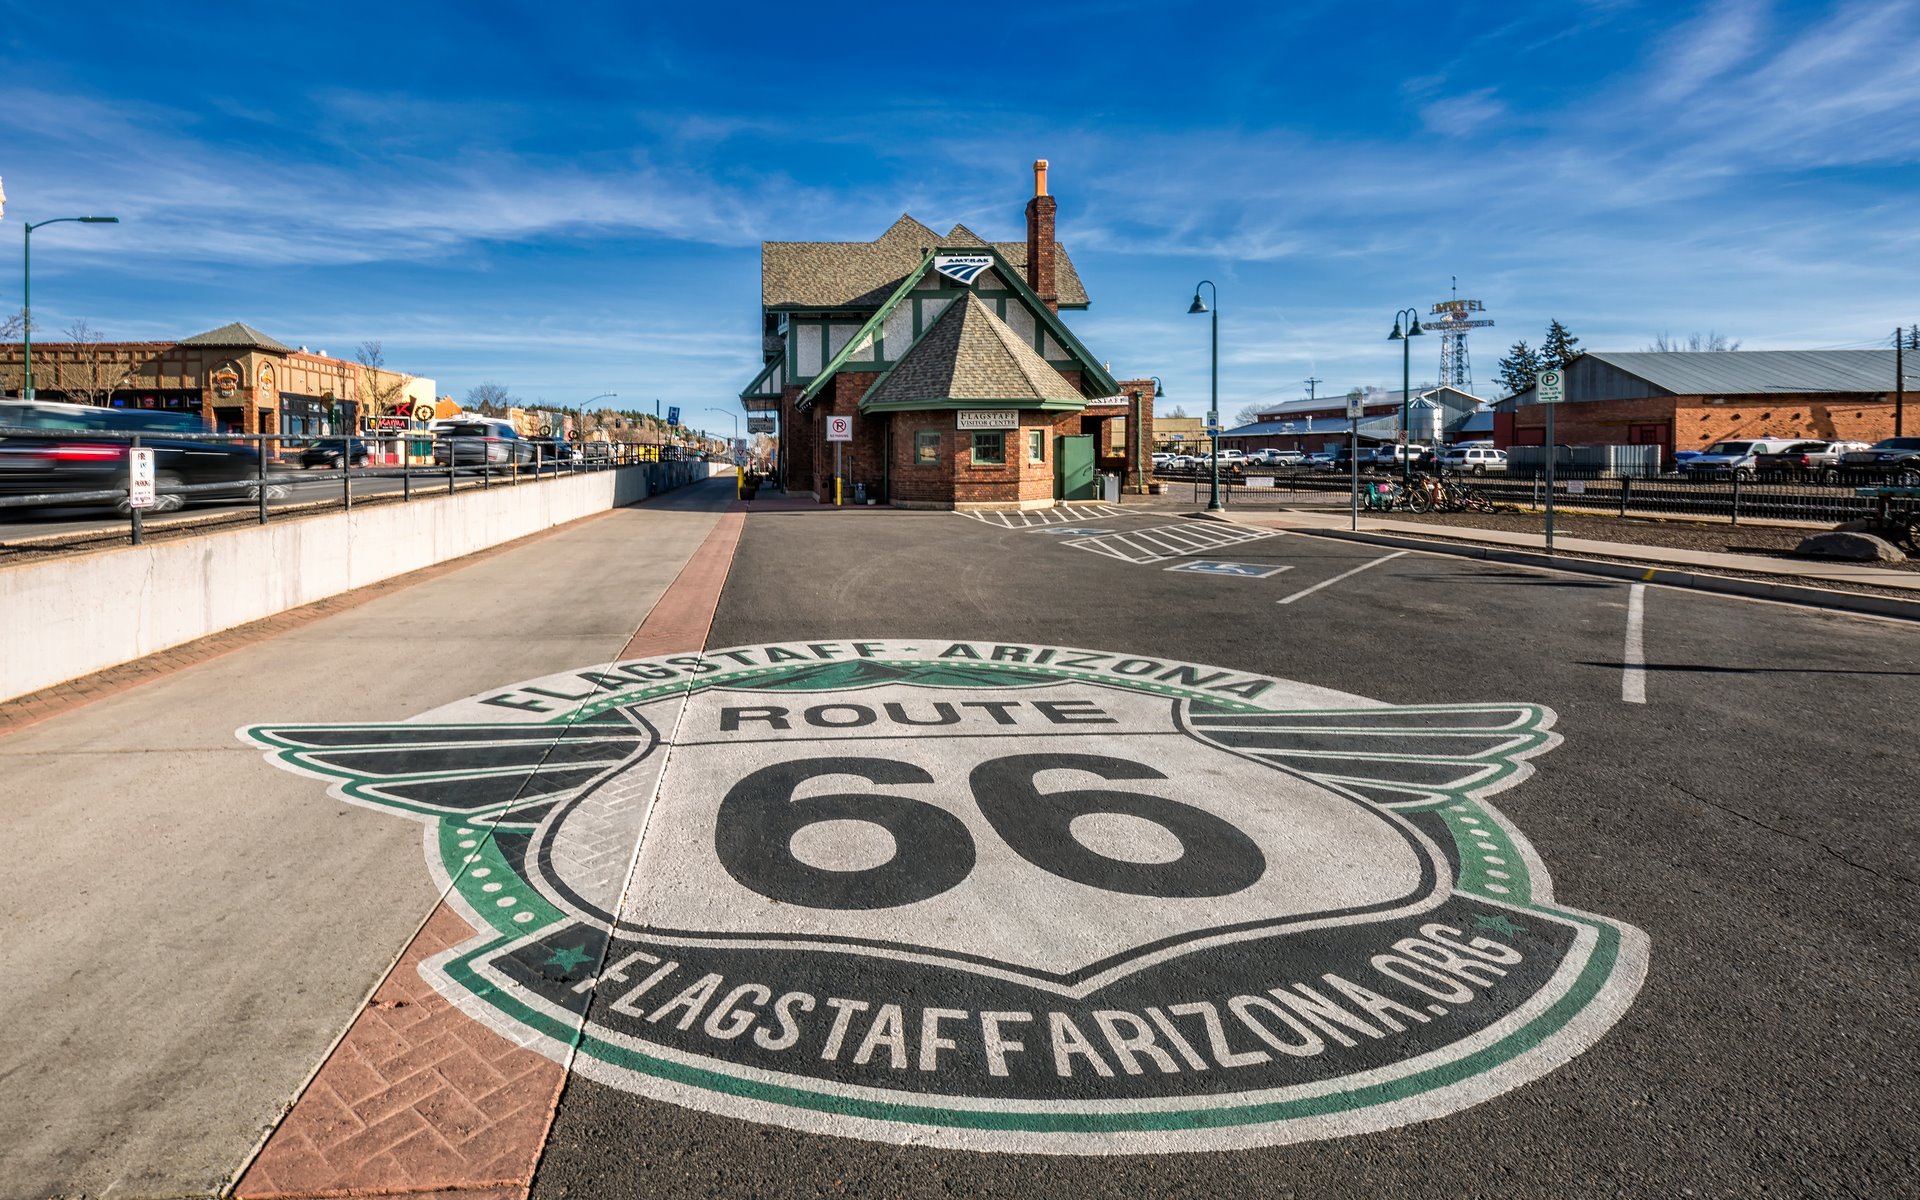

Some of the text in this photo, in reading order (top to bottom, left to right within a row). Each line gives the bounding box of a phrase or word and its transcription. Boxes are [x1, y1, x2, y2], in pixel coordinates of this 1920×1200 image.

[670, 408, 679, 416] H
[961, 412, 1016, 420] FLAGSTAFF
[478, 642, 1276, 714] FLAGSTAFF ARIZONA
[719, 700, 1120, 731] ROUTE
[715, 753, 1265, 910] 66
